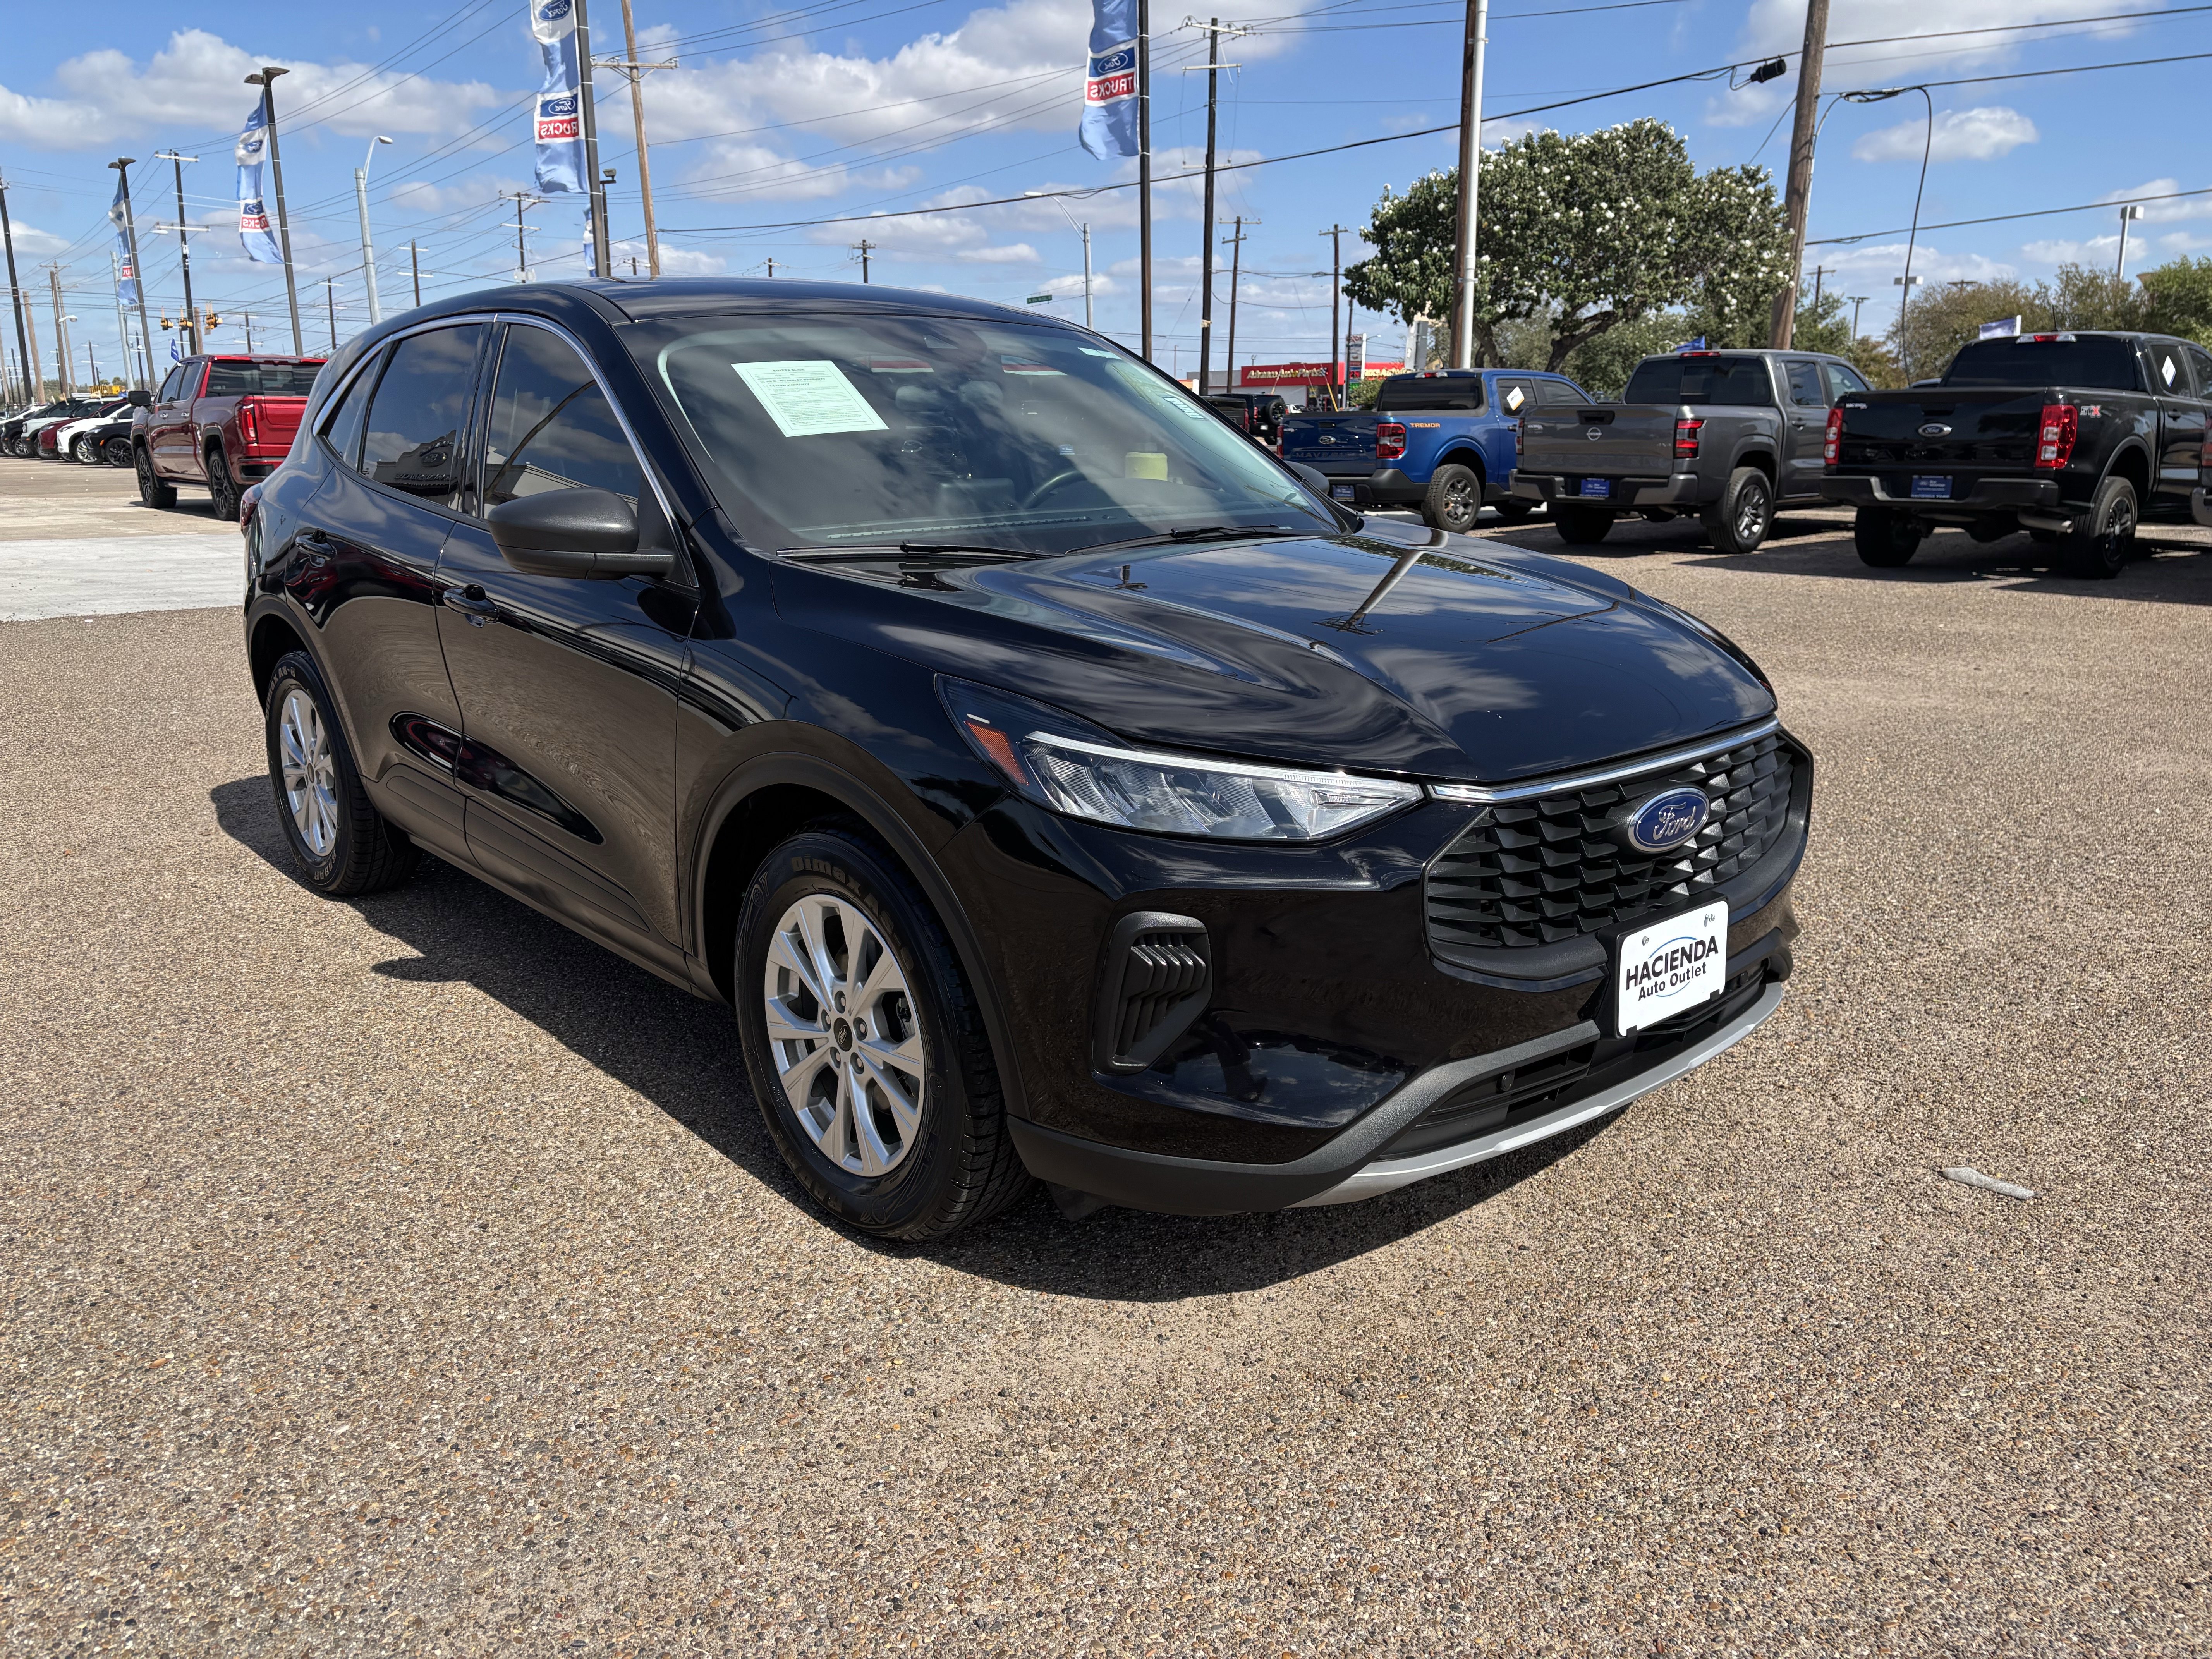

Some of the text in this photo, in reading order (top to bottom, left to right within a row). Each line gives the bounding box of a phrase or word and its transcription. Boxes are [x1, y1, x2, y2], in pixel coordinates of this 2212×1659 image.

[1653, 802, 1696, 840] Ford
[791, 854, 861, 897] Dimax
[1626, 935, 1719, 991] HACIENDA
[1638, 962, 1706, 1001] Auto Outlet
